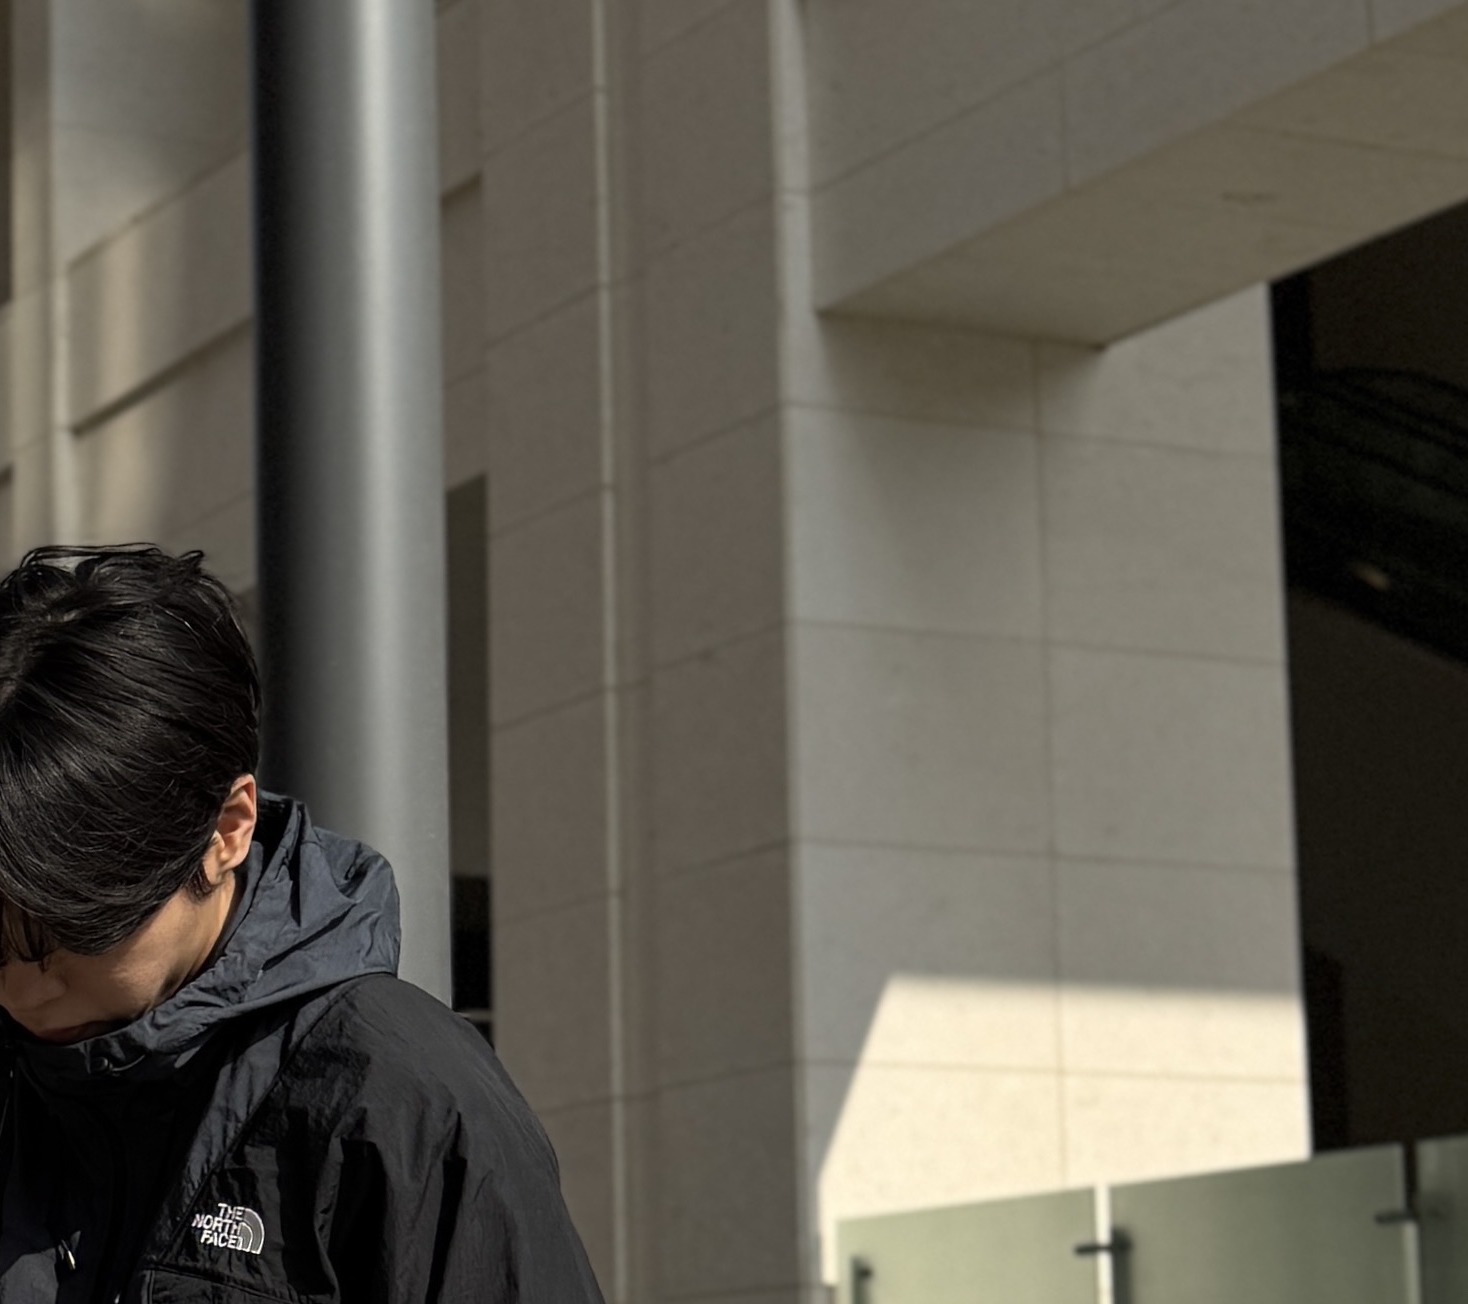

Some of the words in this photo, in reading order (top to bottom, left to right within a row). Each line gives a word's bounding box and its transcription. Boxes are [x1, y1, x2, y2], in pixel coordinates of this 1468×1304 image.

[217, 1202, 245, 1222] THE
[191, 1213, 241, 1236] NORTH
[200, 1229, 239, 1249] FACE
